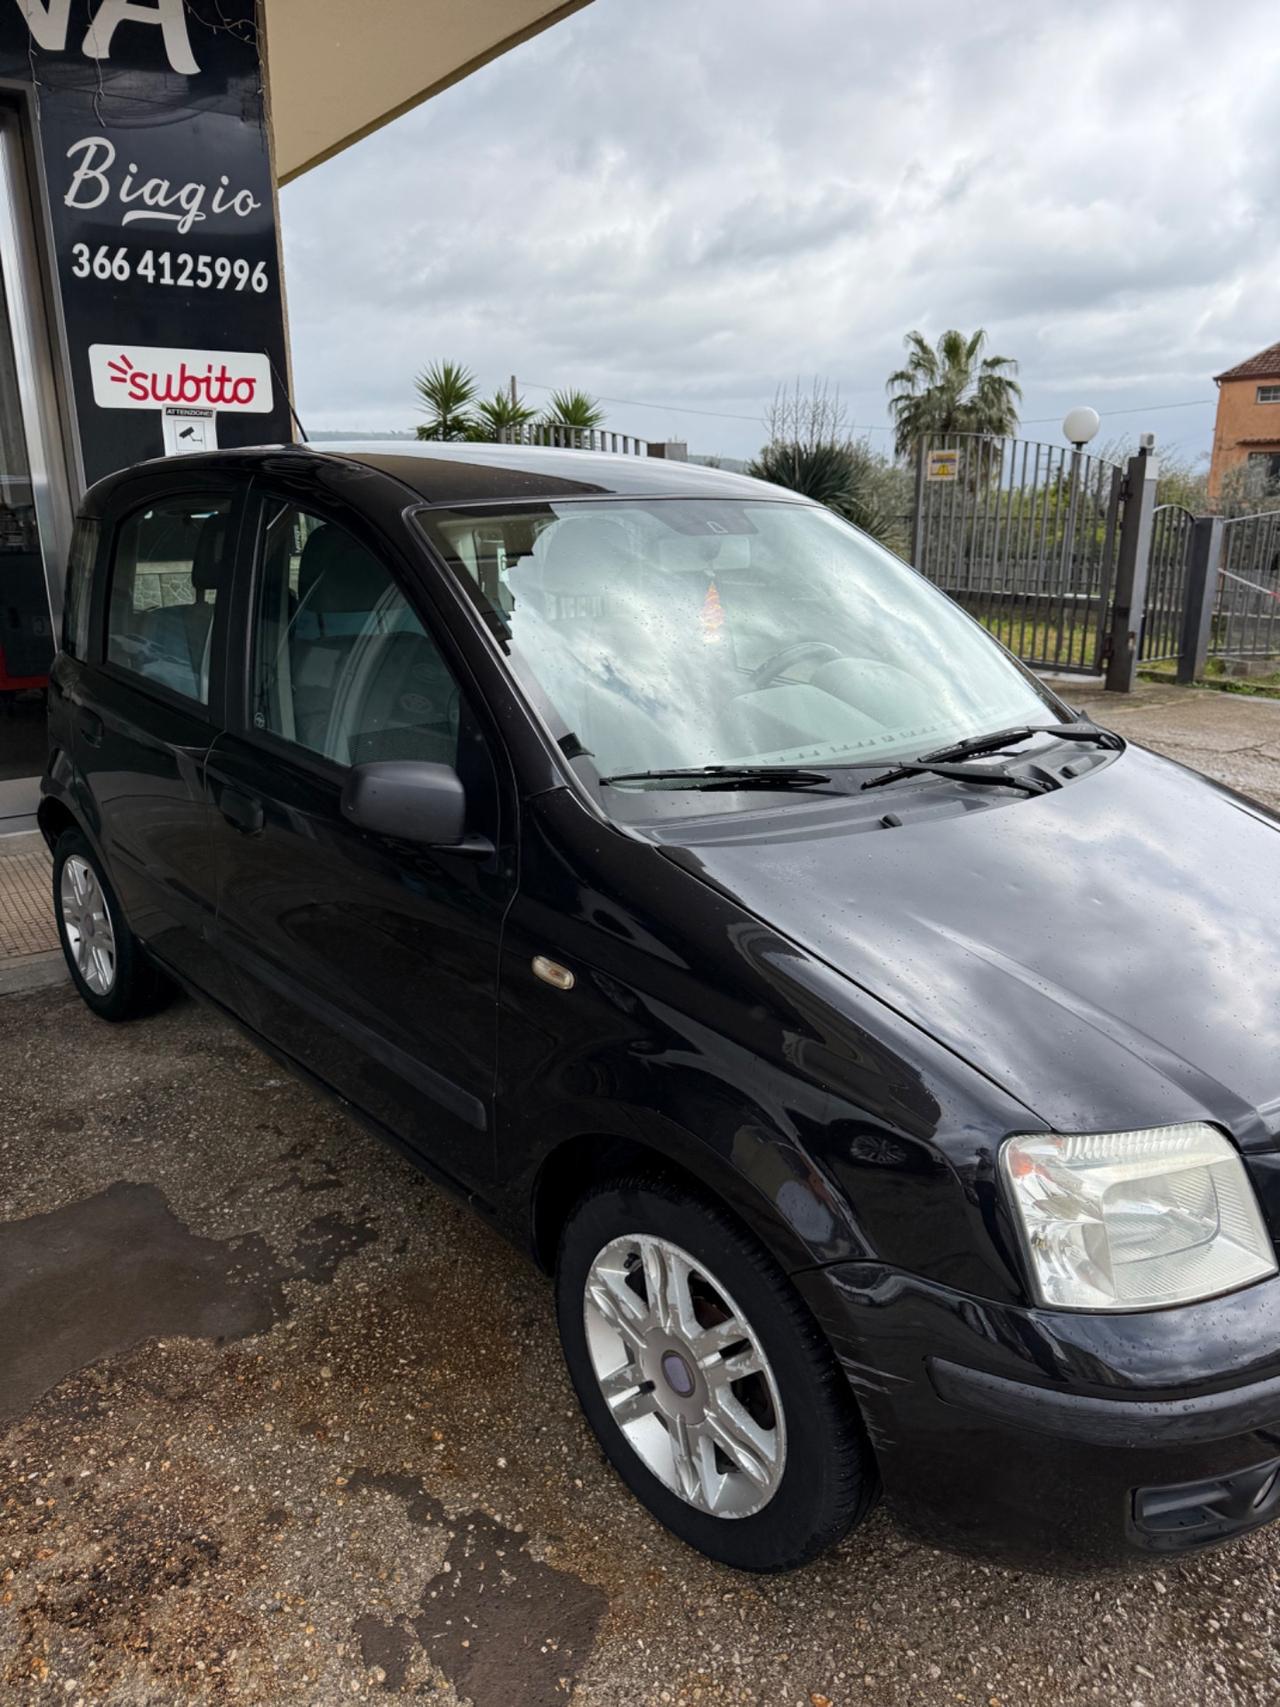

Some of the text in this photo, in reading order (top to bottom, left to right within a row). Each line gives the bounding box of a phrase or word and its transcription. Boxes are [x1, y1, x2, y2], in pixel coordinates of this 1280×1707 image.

[64, 136, 261, 234] Biagio
[72, 243, 268, 293] 366 4125996
[128, 363, 257, 404] subito
